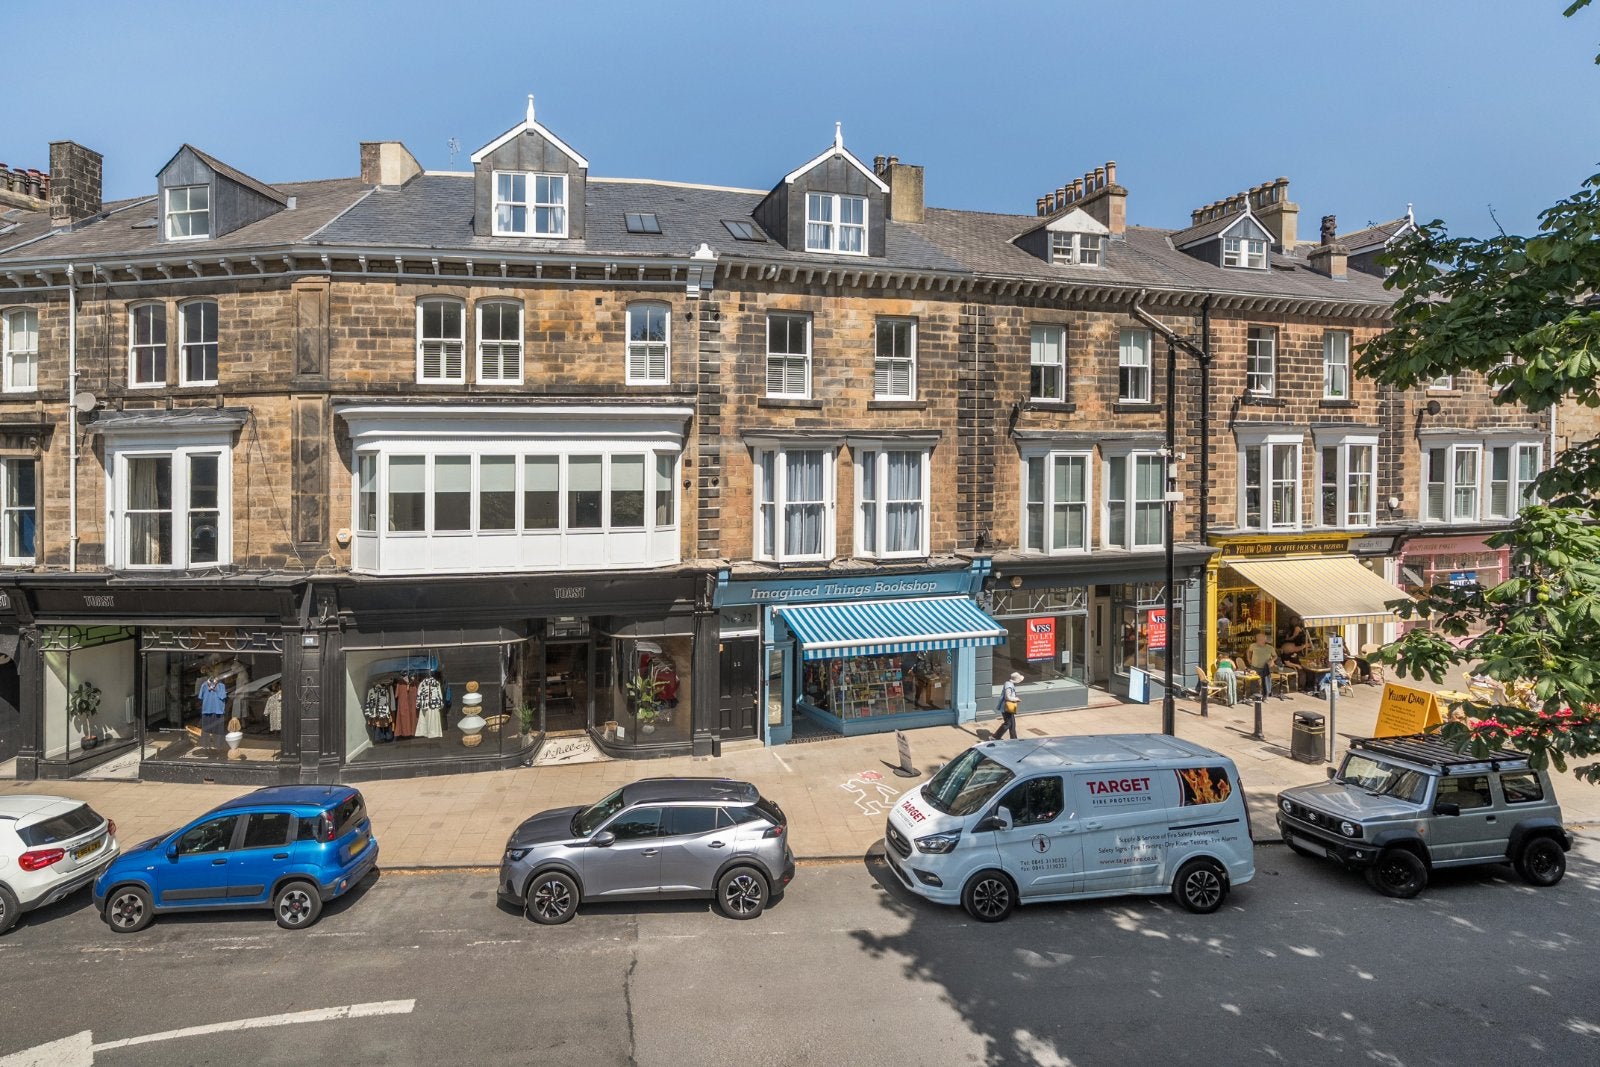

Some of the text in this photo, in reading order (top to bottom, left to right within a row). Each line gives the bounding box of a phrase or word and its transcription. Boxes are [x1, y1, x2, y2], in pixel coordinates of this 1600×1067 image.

[1275, 543, 1295, 552] COFFEE
[1297, 543, 1316, 551] HOUSE
[553, 586, 586, 599] TOAST
[751, 580, 937, 600] Imagined Things Bookshop
[83, 595, 114, 607] TOAST
[1157, 615, 1166, 623] FS
[1036, 623, 1051, 633] FSS
[1040, 632, 1054, 640] LET
[1086, 777, 1150, 794] TARGET
[901, 800, 926, 822] TARGET
[1194, 829, 1220, 837] Equipment
